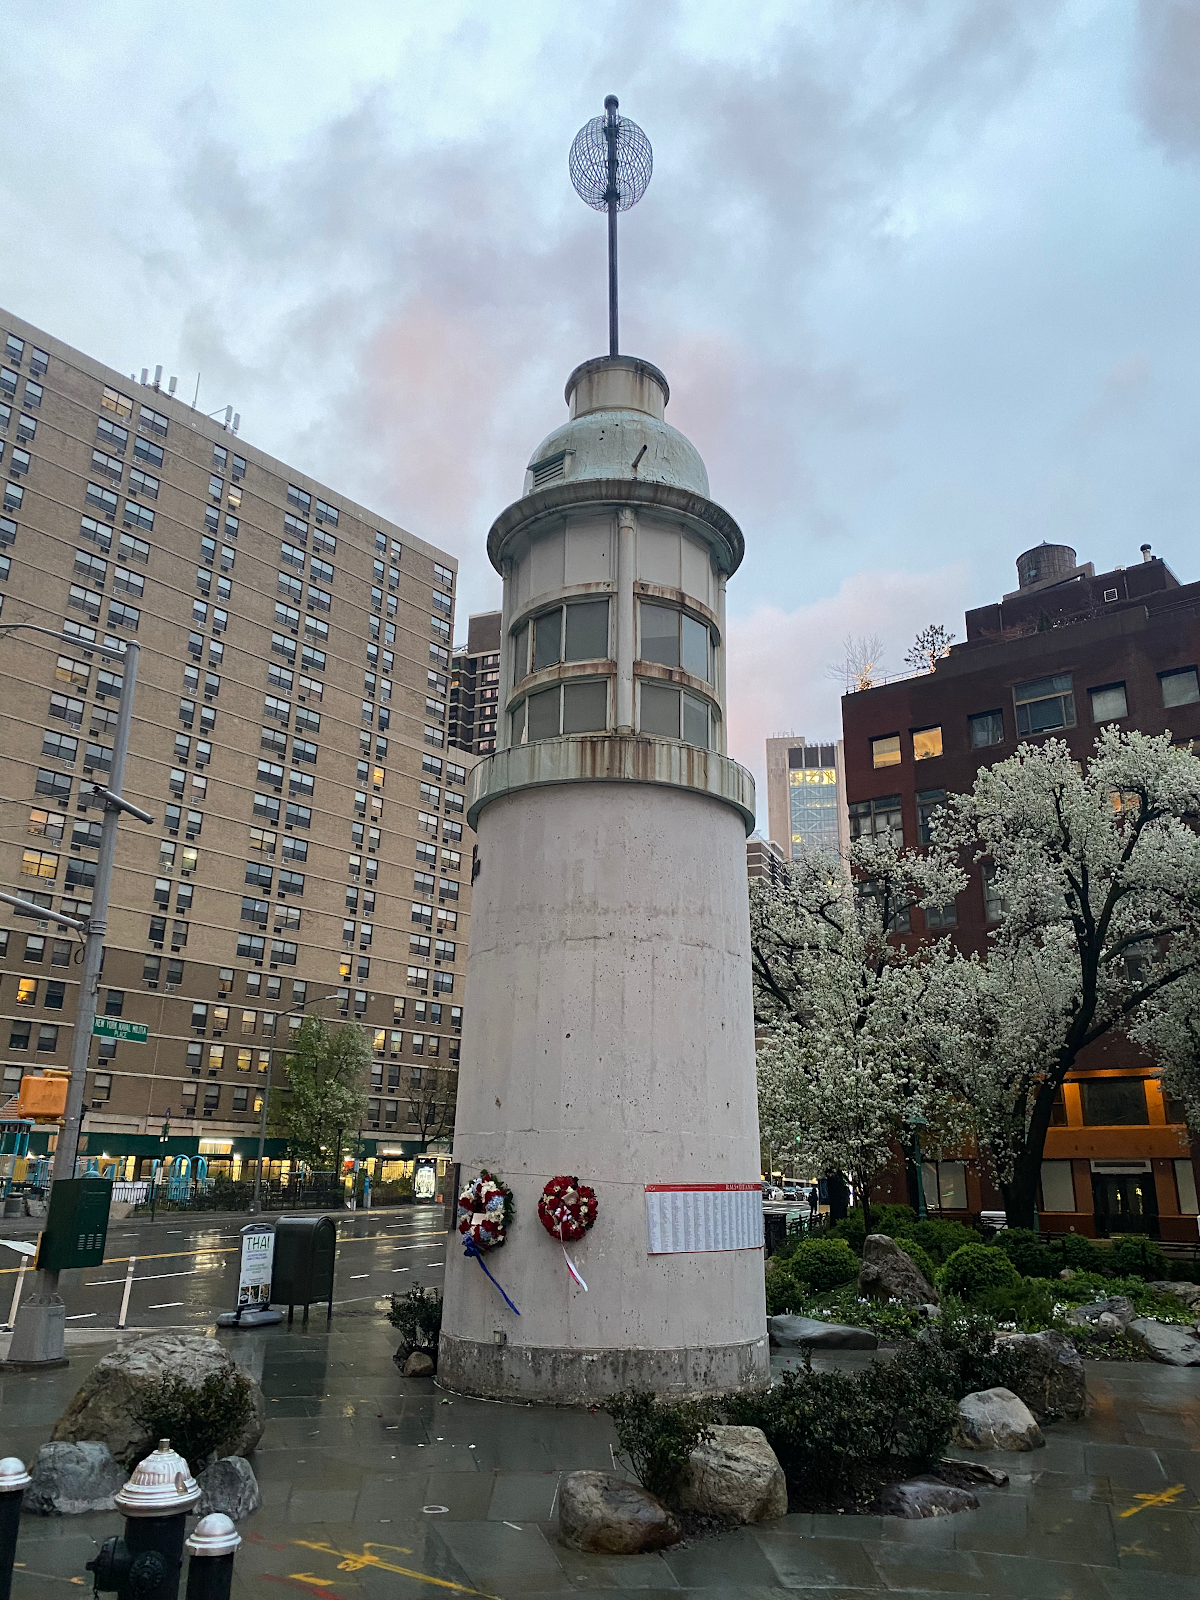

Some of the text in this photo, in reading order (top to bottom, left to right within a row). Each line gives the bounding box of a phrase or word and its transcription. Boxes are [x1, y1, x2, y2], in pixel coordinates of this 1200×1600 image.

[95, 1019, 105, 1027] NEW
[106, 1021, 117, 1029] YORK
[114, 1030, 127, 1038] PLACE
[247, 1236, 270, 1250] THAI
